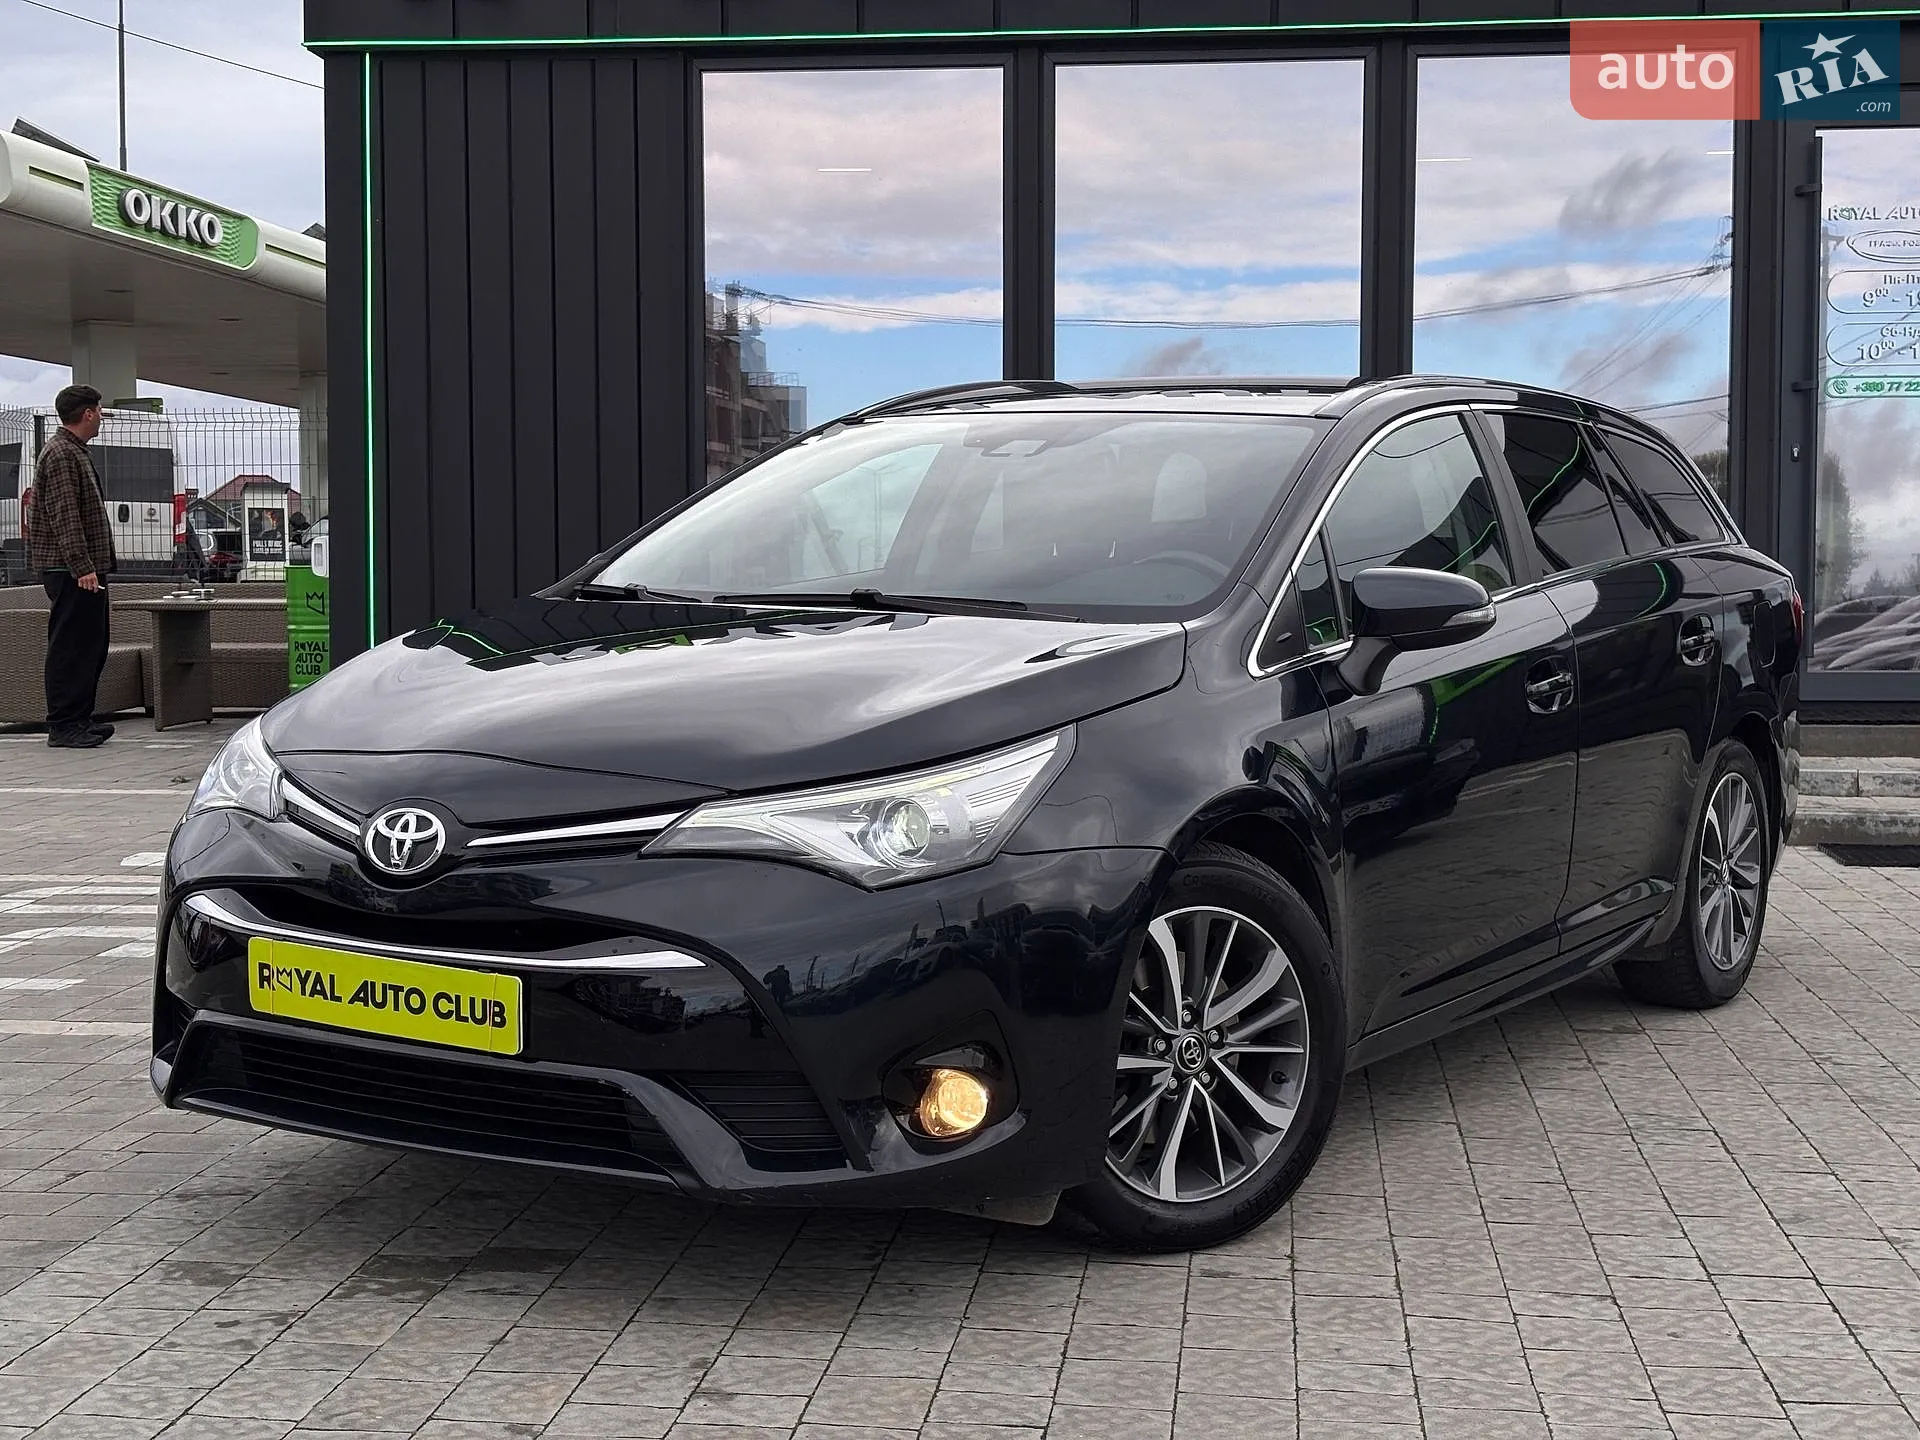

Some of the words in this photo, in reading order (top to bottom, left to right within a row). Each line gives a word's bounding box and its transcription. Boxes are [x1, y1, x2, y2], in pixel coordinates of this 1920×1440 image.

[119, 187, 224, 248] OKKO
[295, 653, 324, 664] AUTO
[295, 664, 321, 675] CLUB
[347, 979, 427, 1016] AUTO
[432, 991, 508, 1029] CLUB
